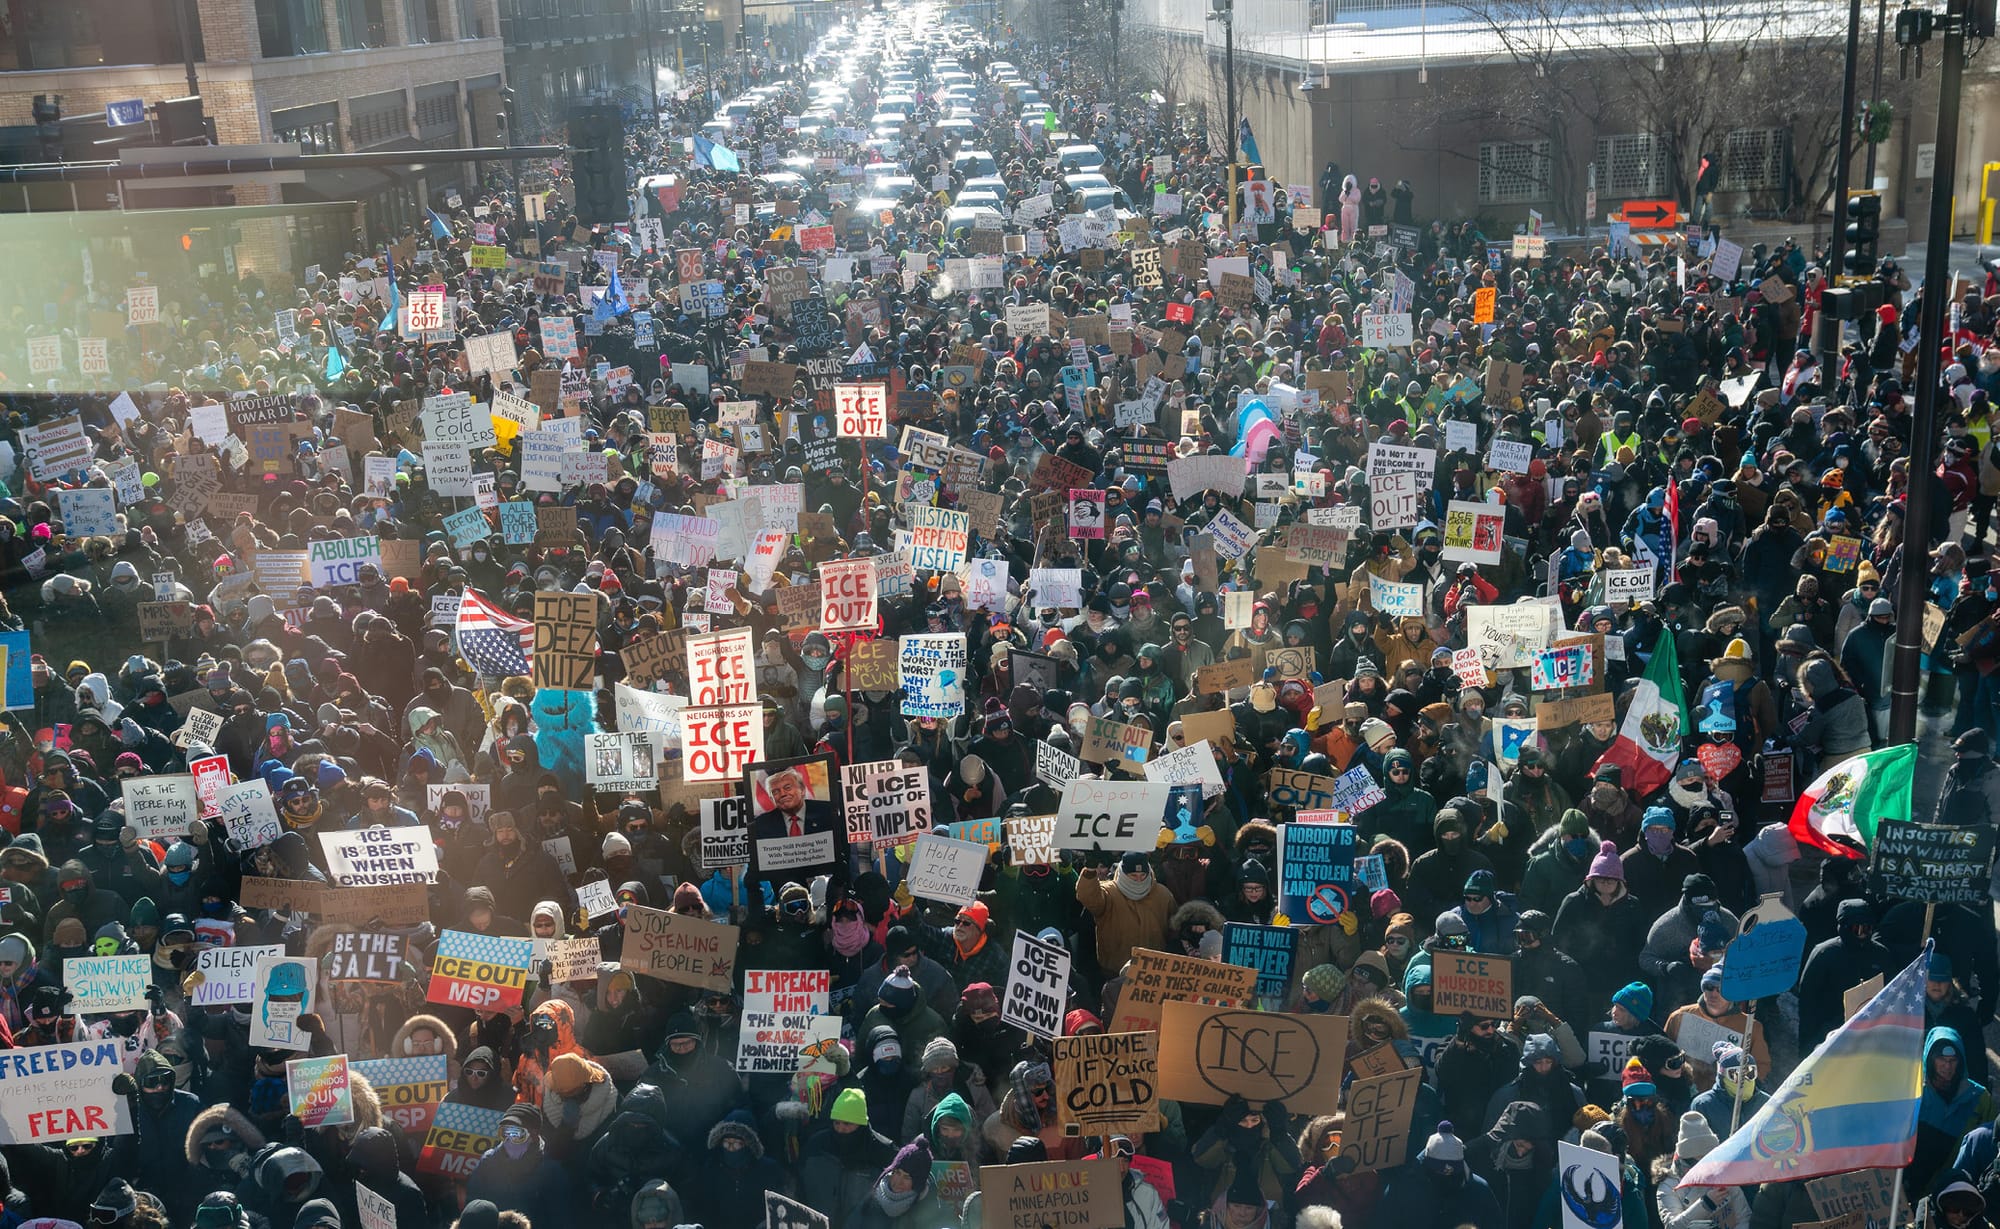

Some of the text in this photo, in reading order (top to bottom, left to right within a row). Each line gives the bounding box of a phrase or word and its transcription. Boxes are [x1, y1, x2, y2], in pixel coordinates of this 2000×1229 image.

[1135, 251, 1160, 263] ICE
[680, 252, 704, 278] 86
[1135, 262, 1160, 274] OUT
[771, 271, 794, 283] NO
[1136, 274, 1161, 285] NOW
[690, 285, 708, 297] BE
[131, 297, 154, 307] ICE
[412, 303, 436, 314] ICE
[793, 300, 825, 312] FUCK
[131, 308, 155, 320] OUT!
[794, 312, 826, 323] THESE
[1365, 315, 1399, 326] MICRO
[412, 316, 439, 328] OUT!
[1368, 326, 1405, 339] PENIS
[806, 358, 843, 374] RIGHTS
[812, 377, 841, 390] LAWS
[25, 427, 69, 445] INVADING
[655, 435, 670, 443] NO
[650, 445, 675, 453] FAUX
[1495, 441, 1527, 453] ARREST
[651, 453, 676, 463] KING
[1492, 451, 1528, 463] JONATHAN
[32, 455, 92, 479] EVERYWHERE
[654, 464, 673, 473] WAY
[1498, 460, 1519, 470] ROSS
[1372, 475, 1407, 494] ICE
[1072, 490, 1102, 500] SASHAY
[1373, 495, 1413, 517] OUT
[915, 505, 968, 529] HISTORY
[1377, 512, 1417, 527] OF MN
[913, 527, 966, 550] REPEATS
[1077, 527, 1097, 538] AWAY
[311, 535, 380, 562] ABOLISH
[912, 547, 960, 572] ITSELF
[154, 575, 173, 583] ICE
[324, 562, 366, 584] ICE
[710, 570, 736, 579] WE ARE
[1609, 574, 1651, 587] ICE OUT
[975, 579, 989, 591] NO
[1619, 586, 1651, 594] MINNESOTA
[157, 593, 175, 601] OUT
[973, 591, 996, 604] ICE
[144, 606, 170, 618] MPLS
[537, 597, 592, 621] ICE
[705, 601, 733, 611] FAMILY
[535, 624, 594, 652] DEEZ
[1455, 649, 1476, 661] GOD
[535, 653, 594, 690] NUTZ
[1454, 660, 1481, 671] KNOWS
[1455, 669, 1481, 679] YOUR
[190, 714, 219, 728] CLEARLY
[201, 712, 215, 721] YOU
[687, 710, 753, 721] NEIGHBORS SAY
[183, 731, 213, 745] HISTORY
[594, 732, 648, 748] SPOT THE
[688, 721, 751, 747] ICE
[689, 750, 756, 774] OUT!
[1037, 743, 1076, 770] HUMAN
[1037, 758, 1078, 779] BEINGS!
[133, 784, 177, 795] WE THE
[597, 780, 651, 792] DIFFERENCE
[877, 774, 920, 793] ICE
[133, 799, 166, 810] PEOPLE,
[872, 790, 926, 808] OUT OF
[1071, 782, 1149, 812] Deport
[139, 813, 186, 826] THE MAN!
[875, 808, 927, 837] MPLS
[1070, 813, 1138, 837] ICE
[360, 830, 392, 843] ICE
[1287, 829, 1353, 845] NOBODY IS
[1886, 825, 1977, 846] INJUSTICE
[342, 843, 415, 859] IS BEST
[795, 841, 814, 850] Polling
[815, 838, 828, 846] Well
[783, 850, 807, 858] Working
[1286, 845, 1332, 863] ILLEGAL
[352, 858, 415, 872] WHEN
[767, 858, 794, 866] American
[1881, 857, 1985, 877] IS A THREAT
[339, 871, 435, 886] CRUSHED!
[1285, 864, 1350, 881] ON STOLEN
[1283, 881, 1316, 896] LAND
[1886, 884, 1983, 901] EVERYWHERE
[629, 909, 672, 933] STOP
[334, 933, 400, 953] BE THE
[639, 932, 719, 953] STEALING
[1231, 928, 1292, 949] HATE WILL
[651, 950, 703, 974] PEOPLE
[1023, 942, 1059, 970] ICE
[1229, 947, 1290, 975] NEVER
[66, 958, 151, 980] SNOWFLAKES
[330, 953, 401, 980] SALT
[434, 957, 526, 987] ICE OUT
[1016, 959, 1062, 989] OUT
[1455, 959, 1489, 976] ICE
[746, 970, 829, 993] IMPEACH
[1438, 975, 1505, 995] MURDERS
[448, 982, 500, 1006] MSP
[1013, 981, 1059, 1014] OF MN
[1436, 992, 1507, 1013] AMERICANS
[747, 1013, 815, 1030] THE ONLY
[1006, 1001, 1059, 1032] NOW
[756, 1030, 806, 1045] ORANGE
[741, 1044, 799, 1058] MONARCH
[0, 1043, 119, 1079] FREEDOM
[738, 1057, 799, 1071] I ADMIRE
[293, 1062, 343, 1076] TODOS SON
[1, 1075, 107, 1097] MEANS FREEDOM
[294, 1075, 344, 1089] BIENVENIDOS
[36, 1094, 77, 1104] FROM
[296, 1086, 332, 1104] AQUÍ
[27, 1105, 109, 1137] FEAR
[1014, 1171, 1089, 1192] A UNIQUE
[1009, 1190, 1090, 1211] MINNEAPOLIS
[1014, 1210, 1090, 1228] REACTION
